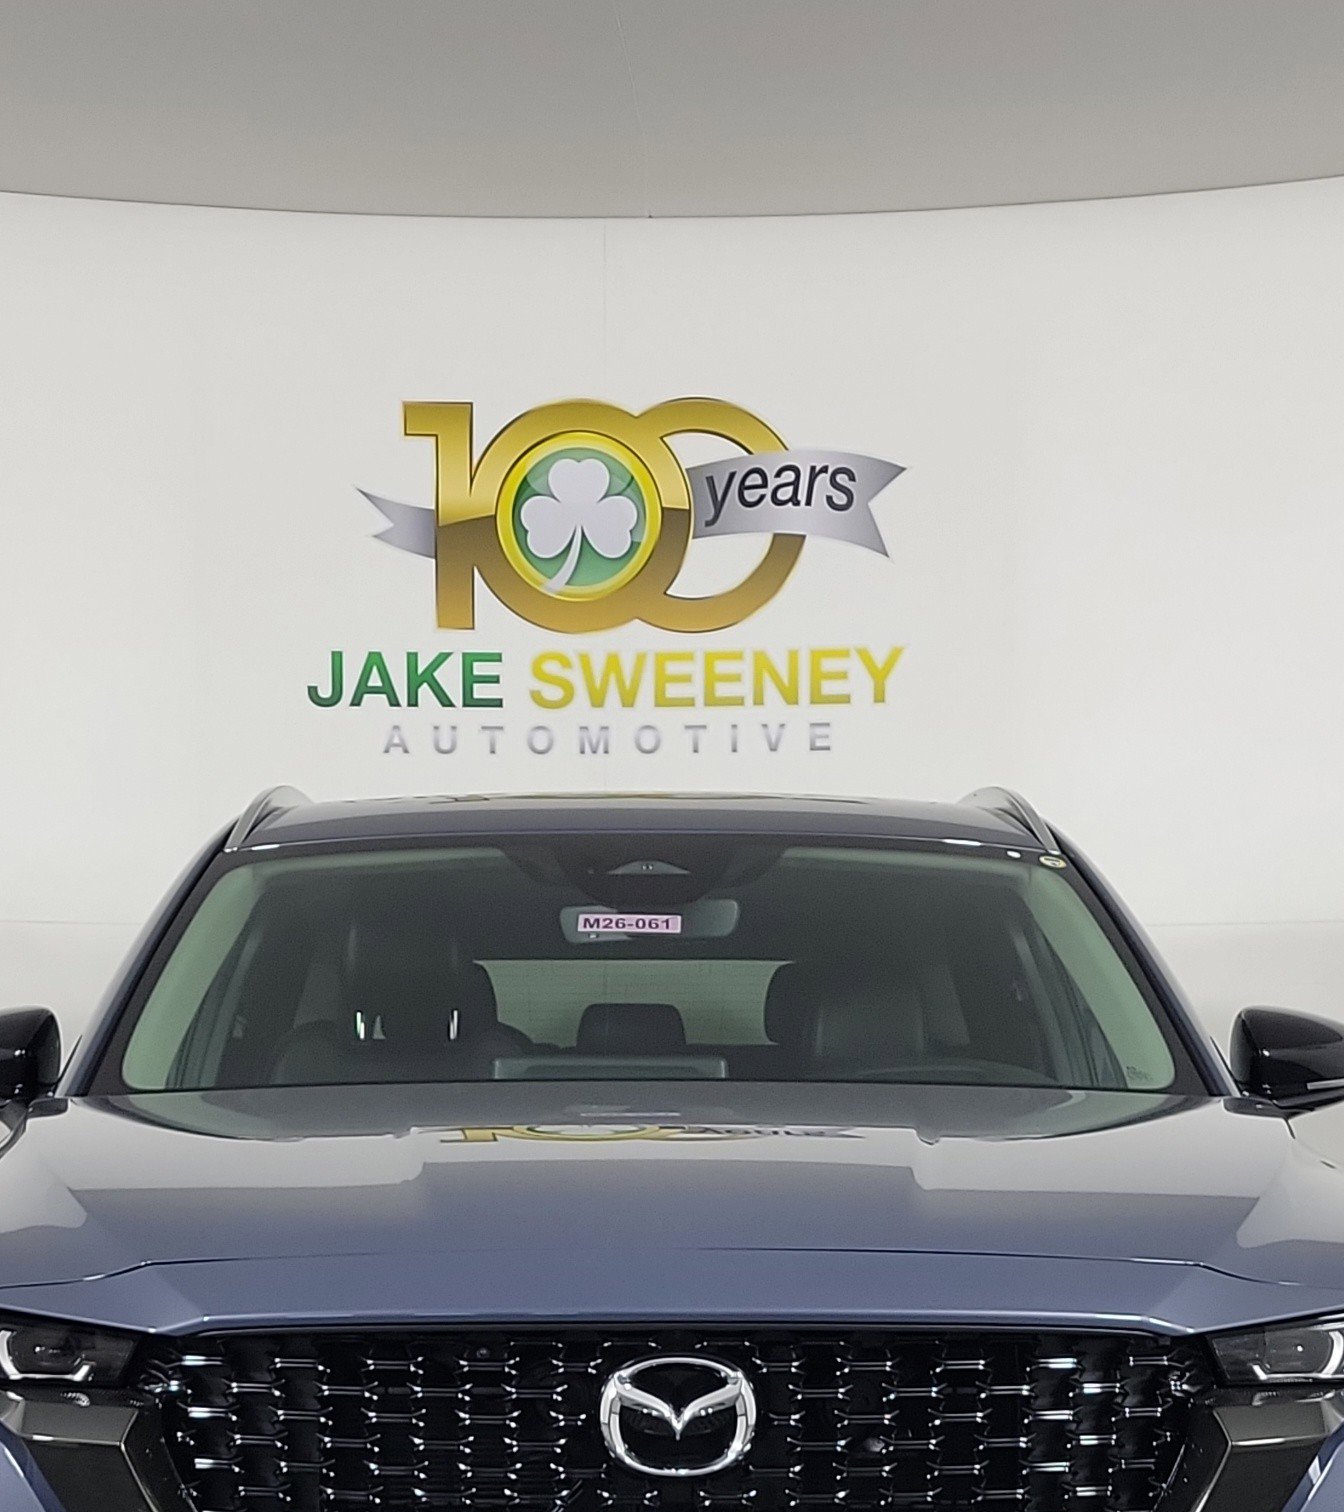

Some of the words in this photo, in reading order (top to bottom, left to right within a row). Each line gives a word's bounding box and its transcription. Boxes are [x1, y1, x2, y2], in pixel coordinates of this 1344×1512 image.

[402, 397, 807, 633] 100
[703, 462, 857, 528] years
[307, 650, 504, 708] JAKE
[529, 646, 905, 708] SWEENEY
[383, 722, 833, 755] AUTOMOTIVE
[583, 917, 671, 930] M26-061
